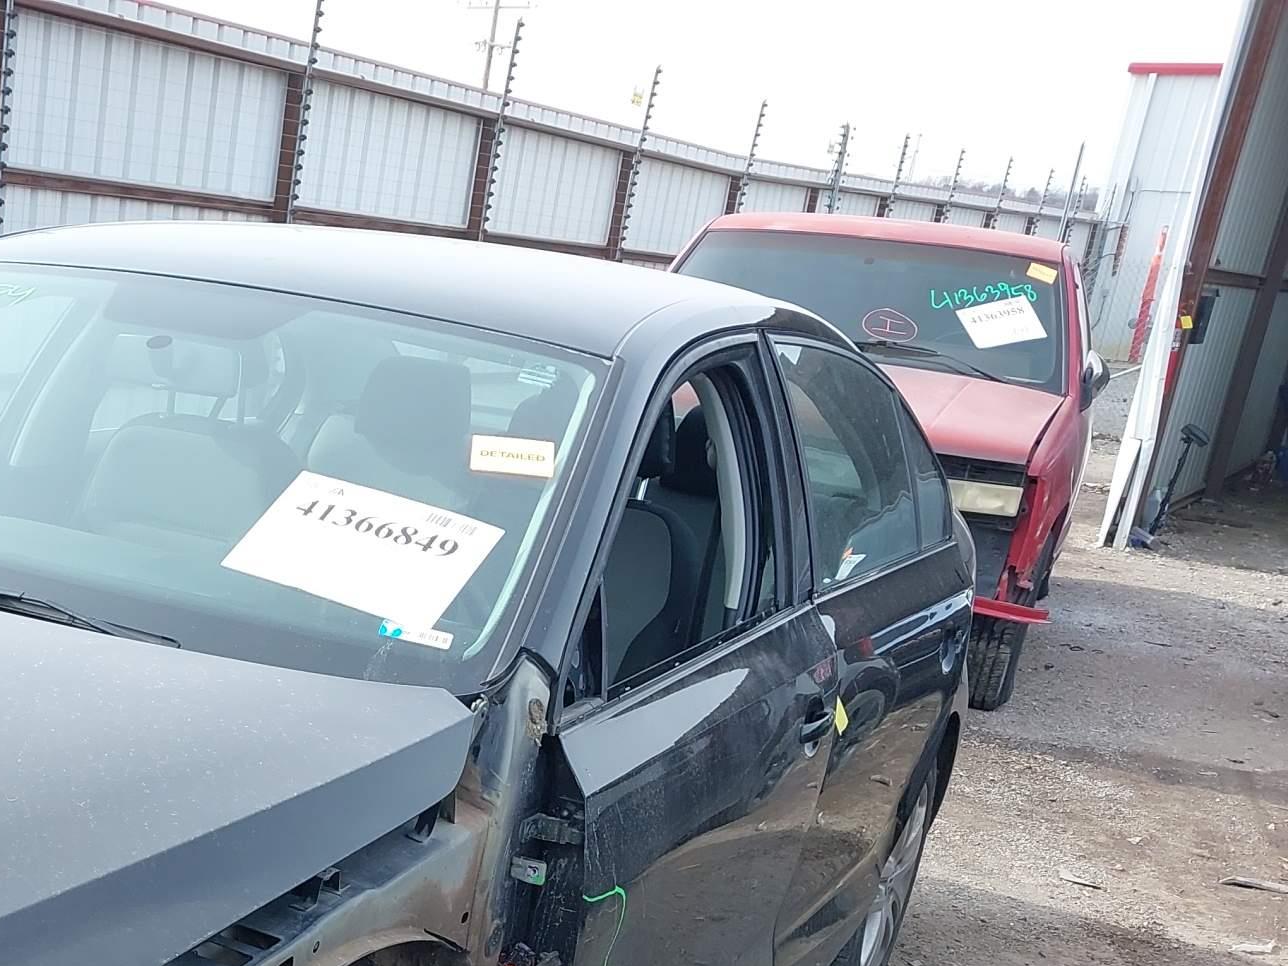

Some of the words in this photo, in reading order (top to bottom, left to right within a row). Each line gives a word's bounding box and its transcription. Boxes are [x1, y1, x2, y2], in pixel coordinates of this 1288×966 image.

[930, 282, 1038, 311] 41363958
[479, 449, 546, 462] DETAILED
[295, 499, 460, 558] 41366849
